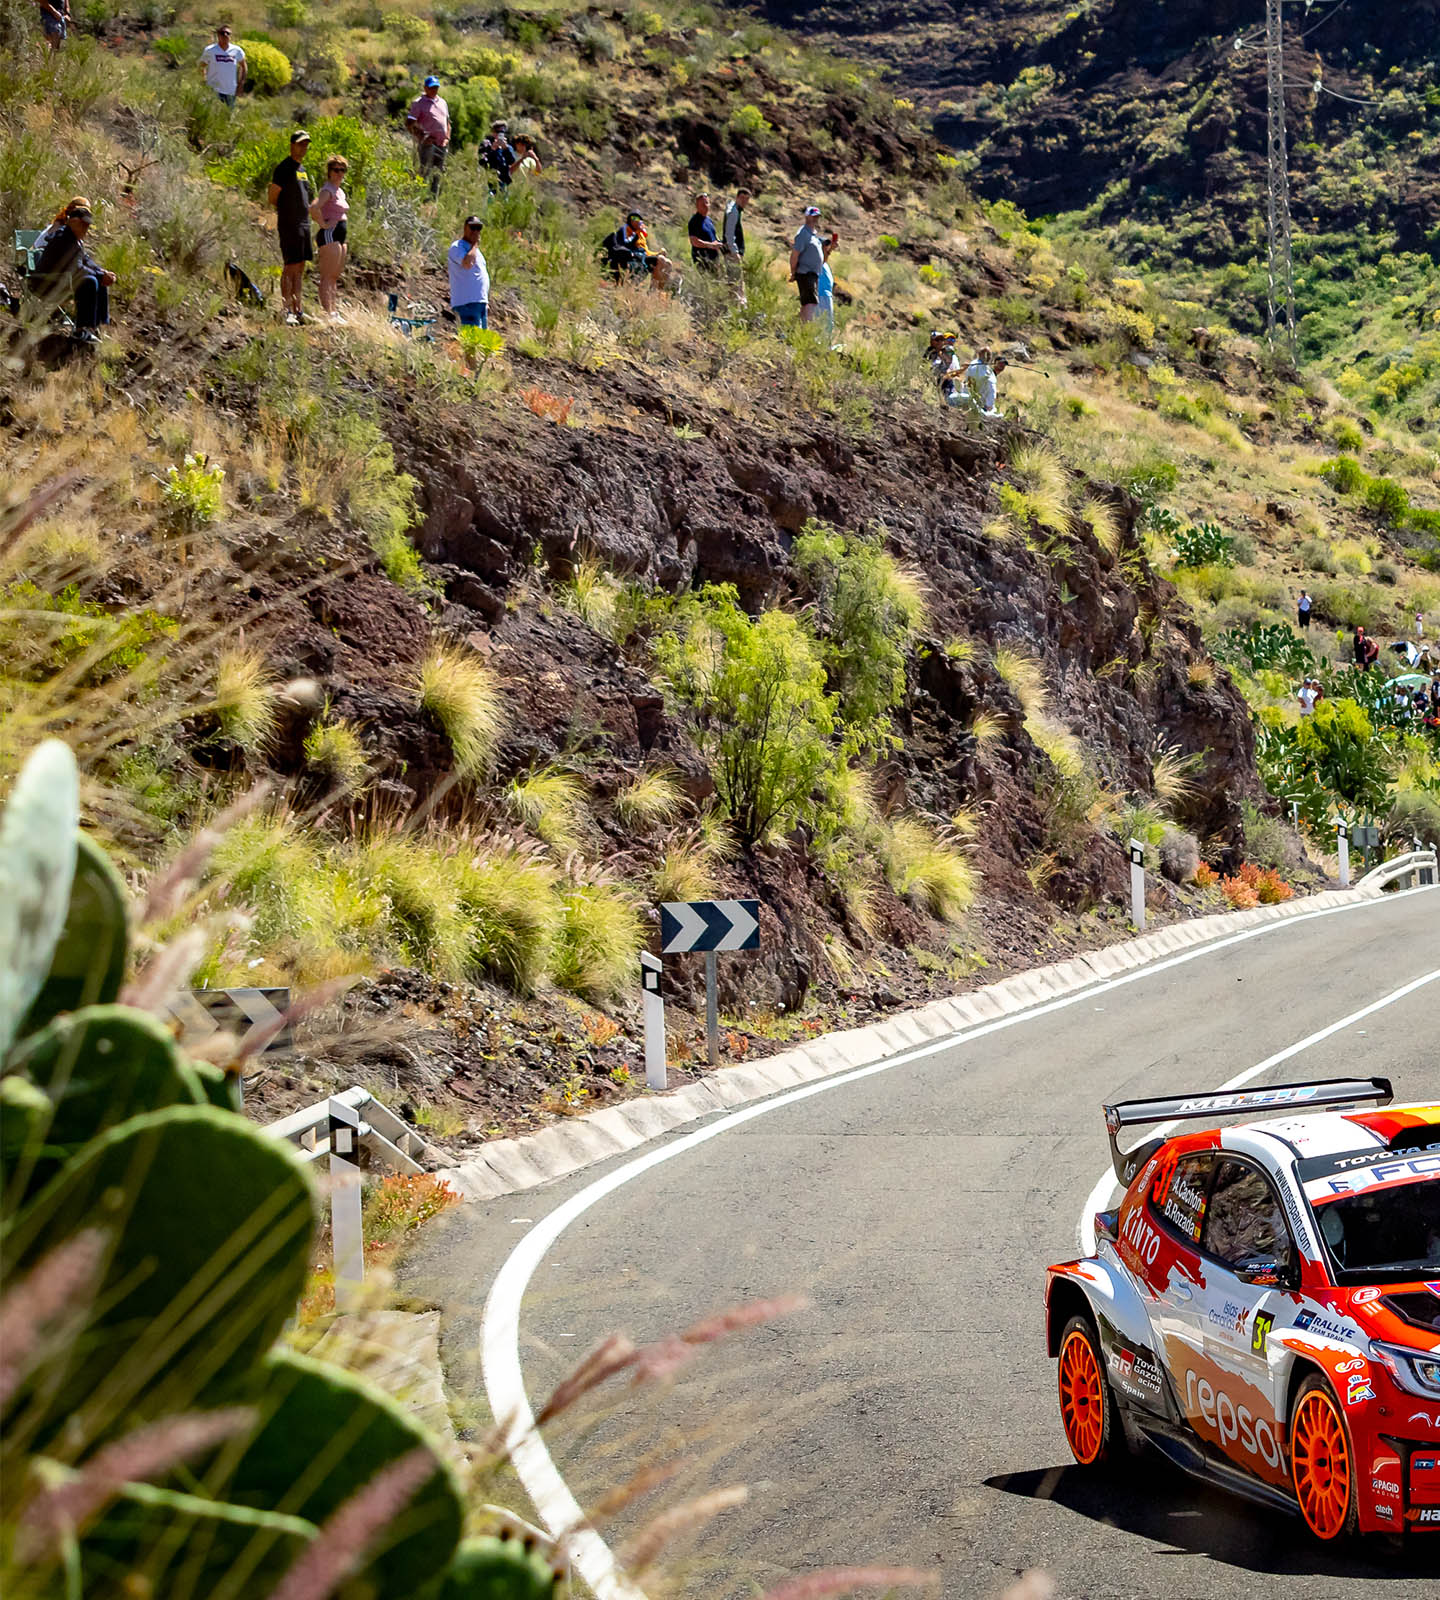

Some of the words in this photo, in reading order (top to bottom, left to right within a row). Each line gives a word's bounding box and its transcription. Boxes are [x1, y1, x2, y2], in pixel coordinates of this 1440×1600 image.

[1334, 1145, 1422, 1168] TOYOTA
[1164, 1198, 1195, 1237] B.Rozada
[1275, 1167, 1312, 1252] www.msispain.com
[1254, 1316, 1272, 1353] 31
[1311, 1326, 1326, 1336] TEAM
[1313, 1317, 1356, 1339] RALLYE
[1110, 1352, 1132, 1376] GR
[1133, 1365, 1162, 1385] GAZOO
[1136, 1356, 1163, 1377] TOYOTA
[1121, 1380, 1145, 1400] Spain
[1186, 1368, 1288, 1477] repsol
[1378, 1479, 1400, 1494] PAGID
